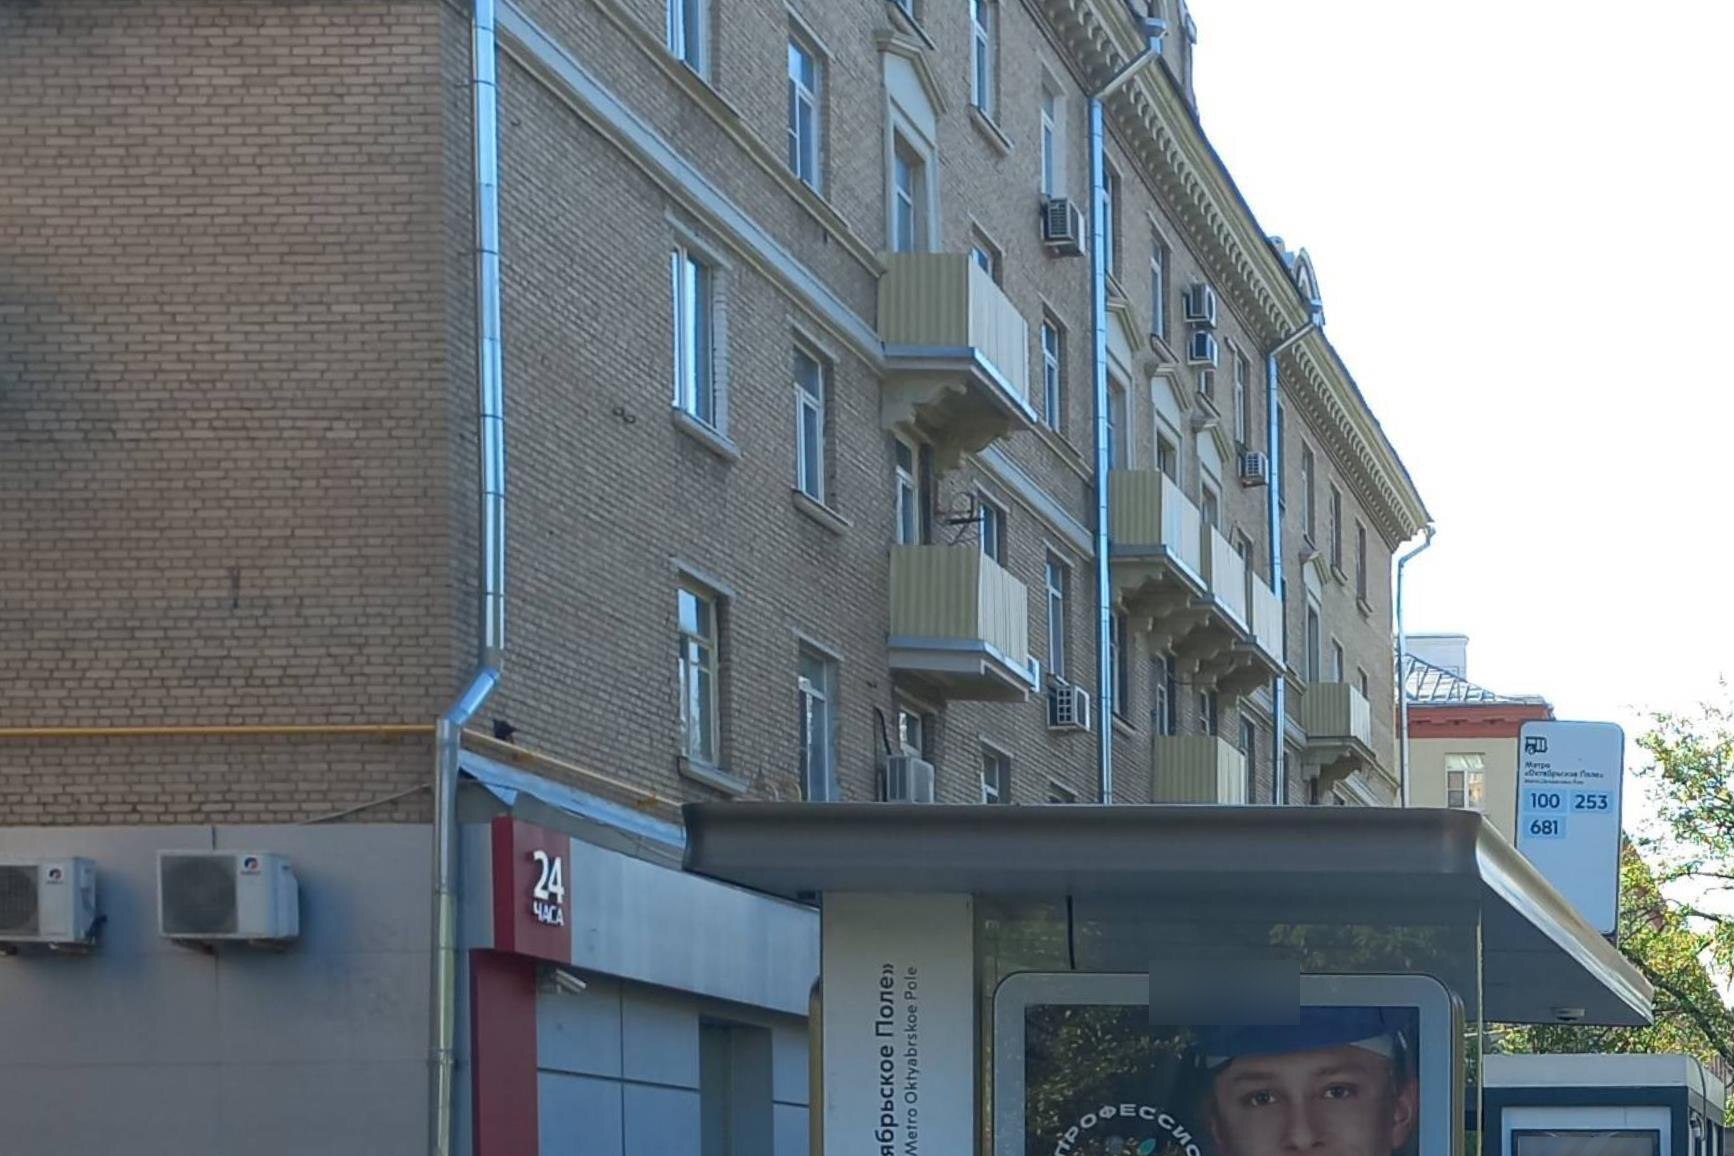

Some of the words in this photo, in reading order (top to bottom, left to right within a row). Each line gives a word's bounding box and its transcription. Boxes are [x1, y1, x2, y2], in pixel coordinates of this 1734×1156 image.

[1531, 793, 1560, 808] 100
[1575, 794, 1608, 809] 253
[1530, 820, 1558, 835] 681
[533, 850, 565, 904] 24
[533, 900, 565, 926] ЧАСА
[875, 963, 894, 1037] Поле»
[904, 966, 918, 1000] Pole
[903, 1004, 920, 1104] Oktyabrskoe
[904, 1107, 918, 1156] Metro
